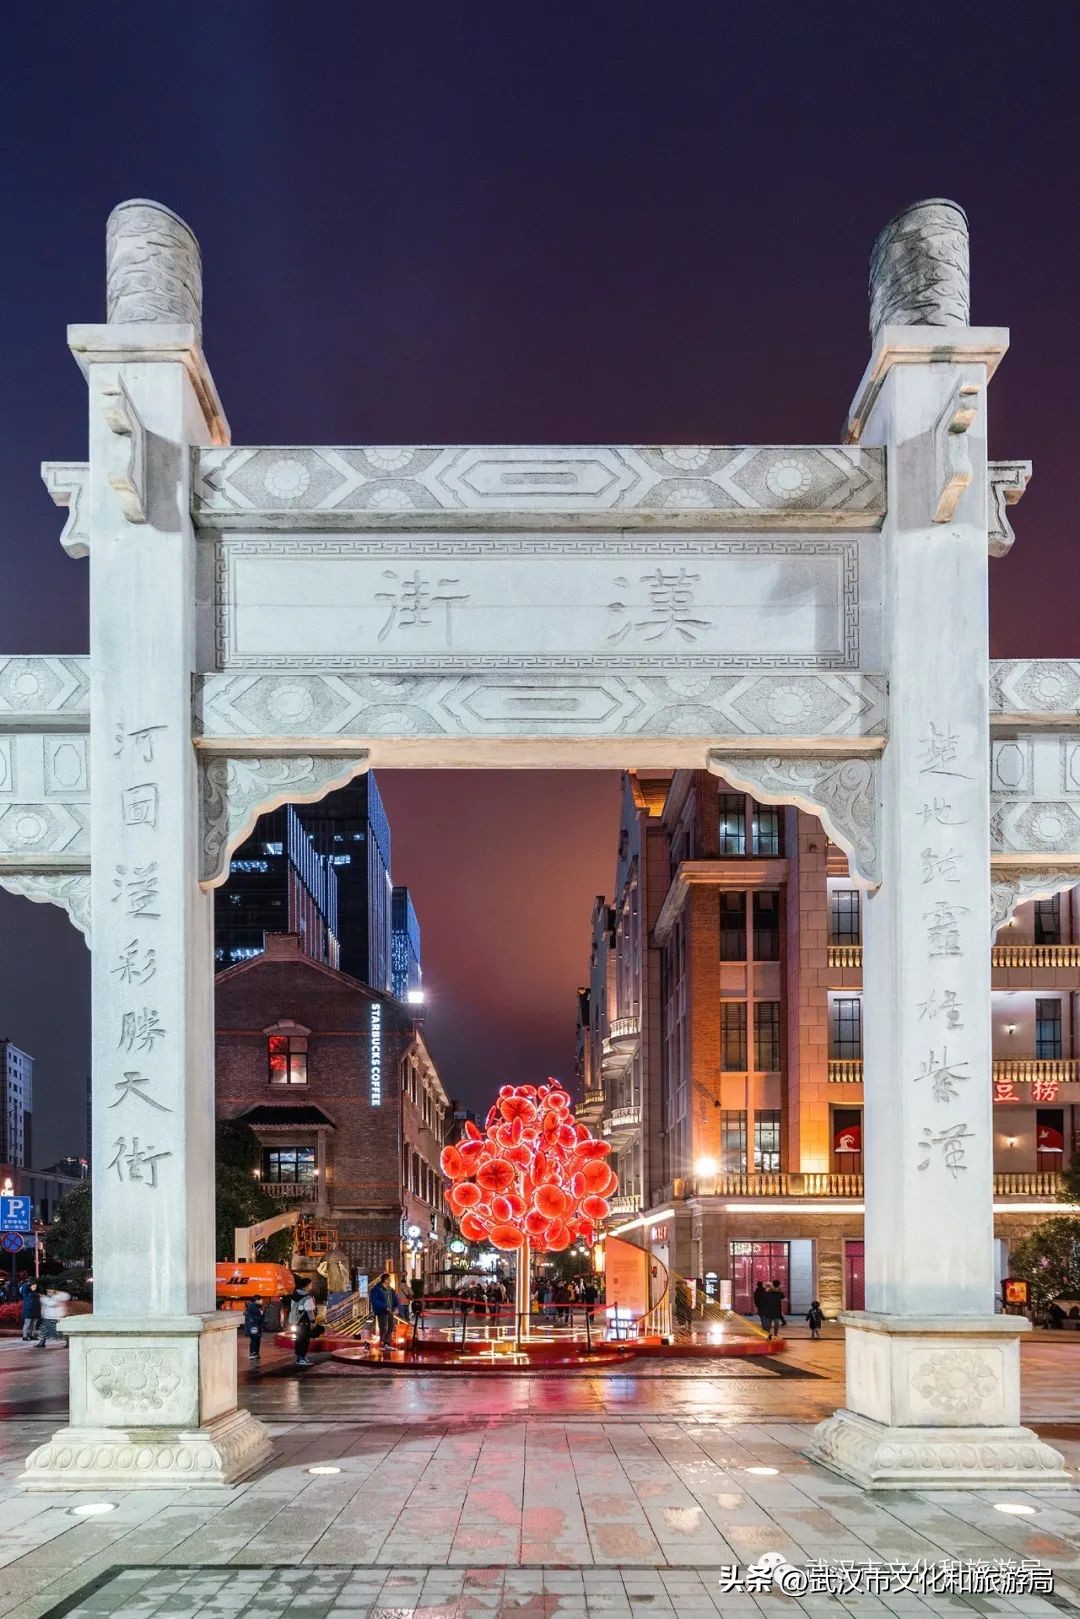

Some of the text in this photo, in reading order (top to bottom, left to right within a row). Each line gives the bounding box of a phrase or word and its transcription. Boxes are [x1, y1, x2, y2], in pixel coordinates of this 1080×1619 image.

[371, 1003, 381, 1106] STARBUCKS COFFEE
[7, 1199, 24, 1218] P
[226, 1277, 250, 1285] JLG
